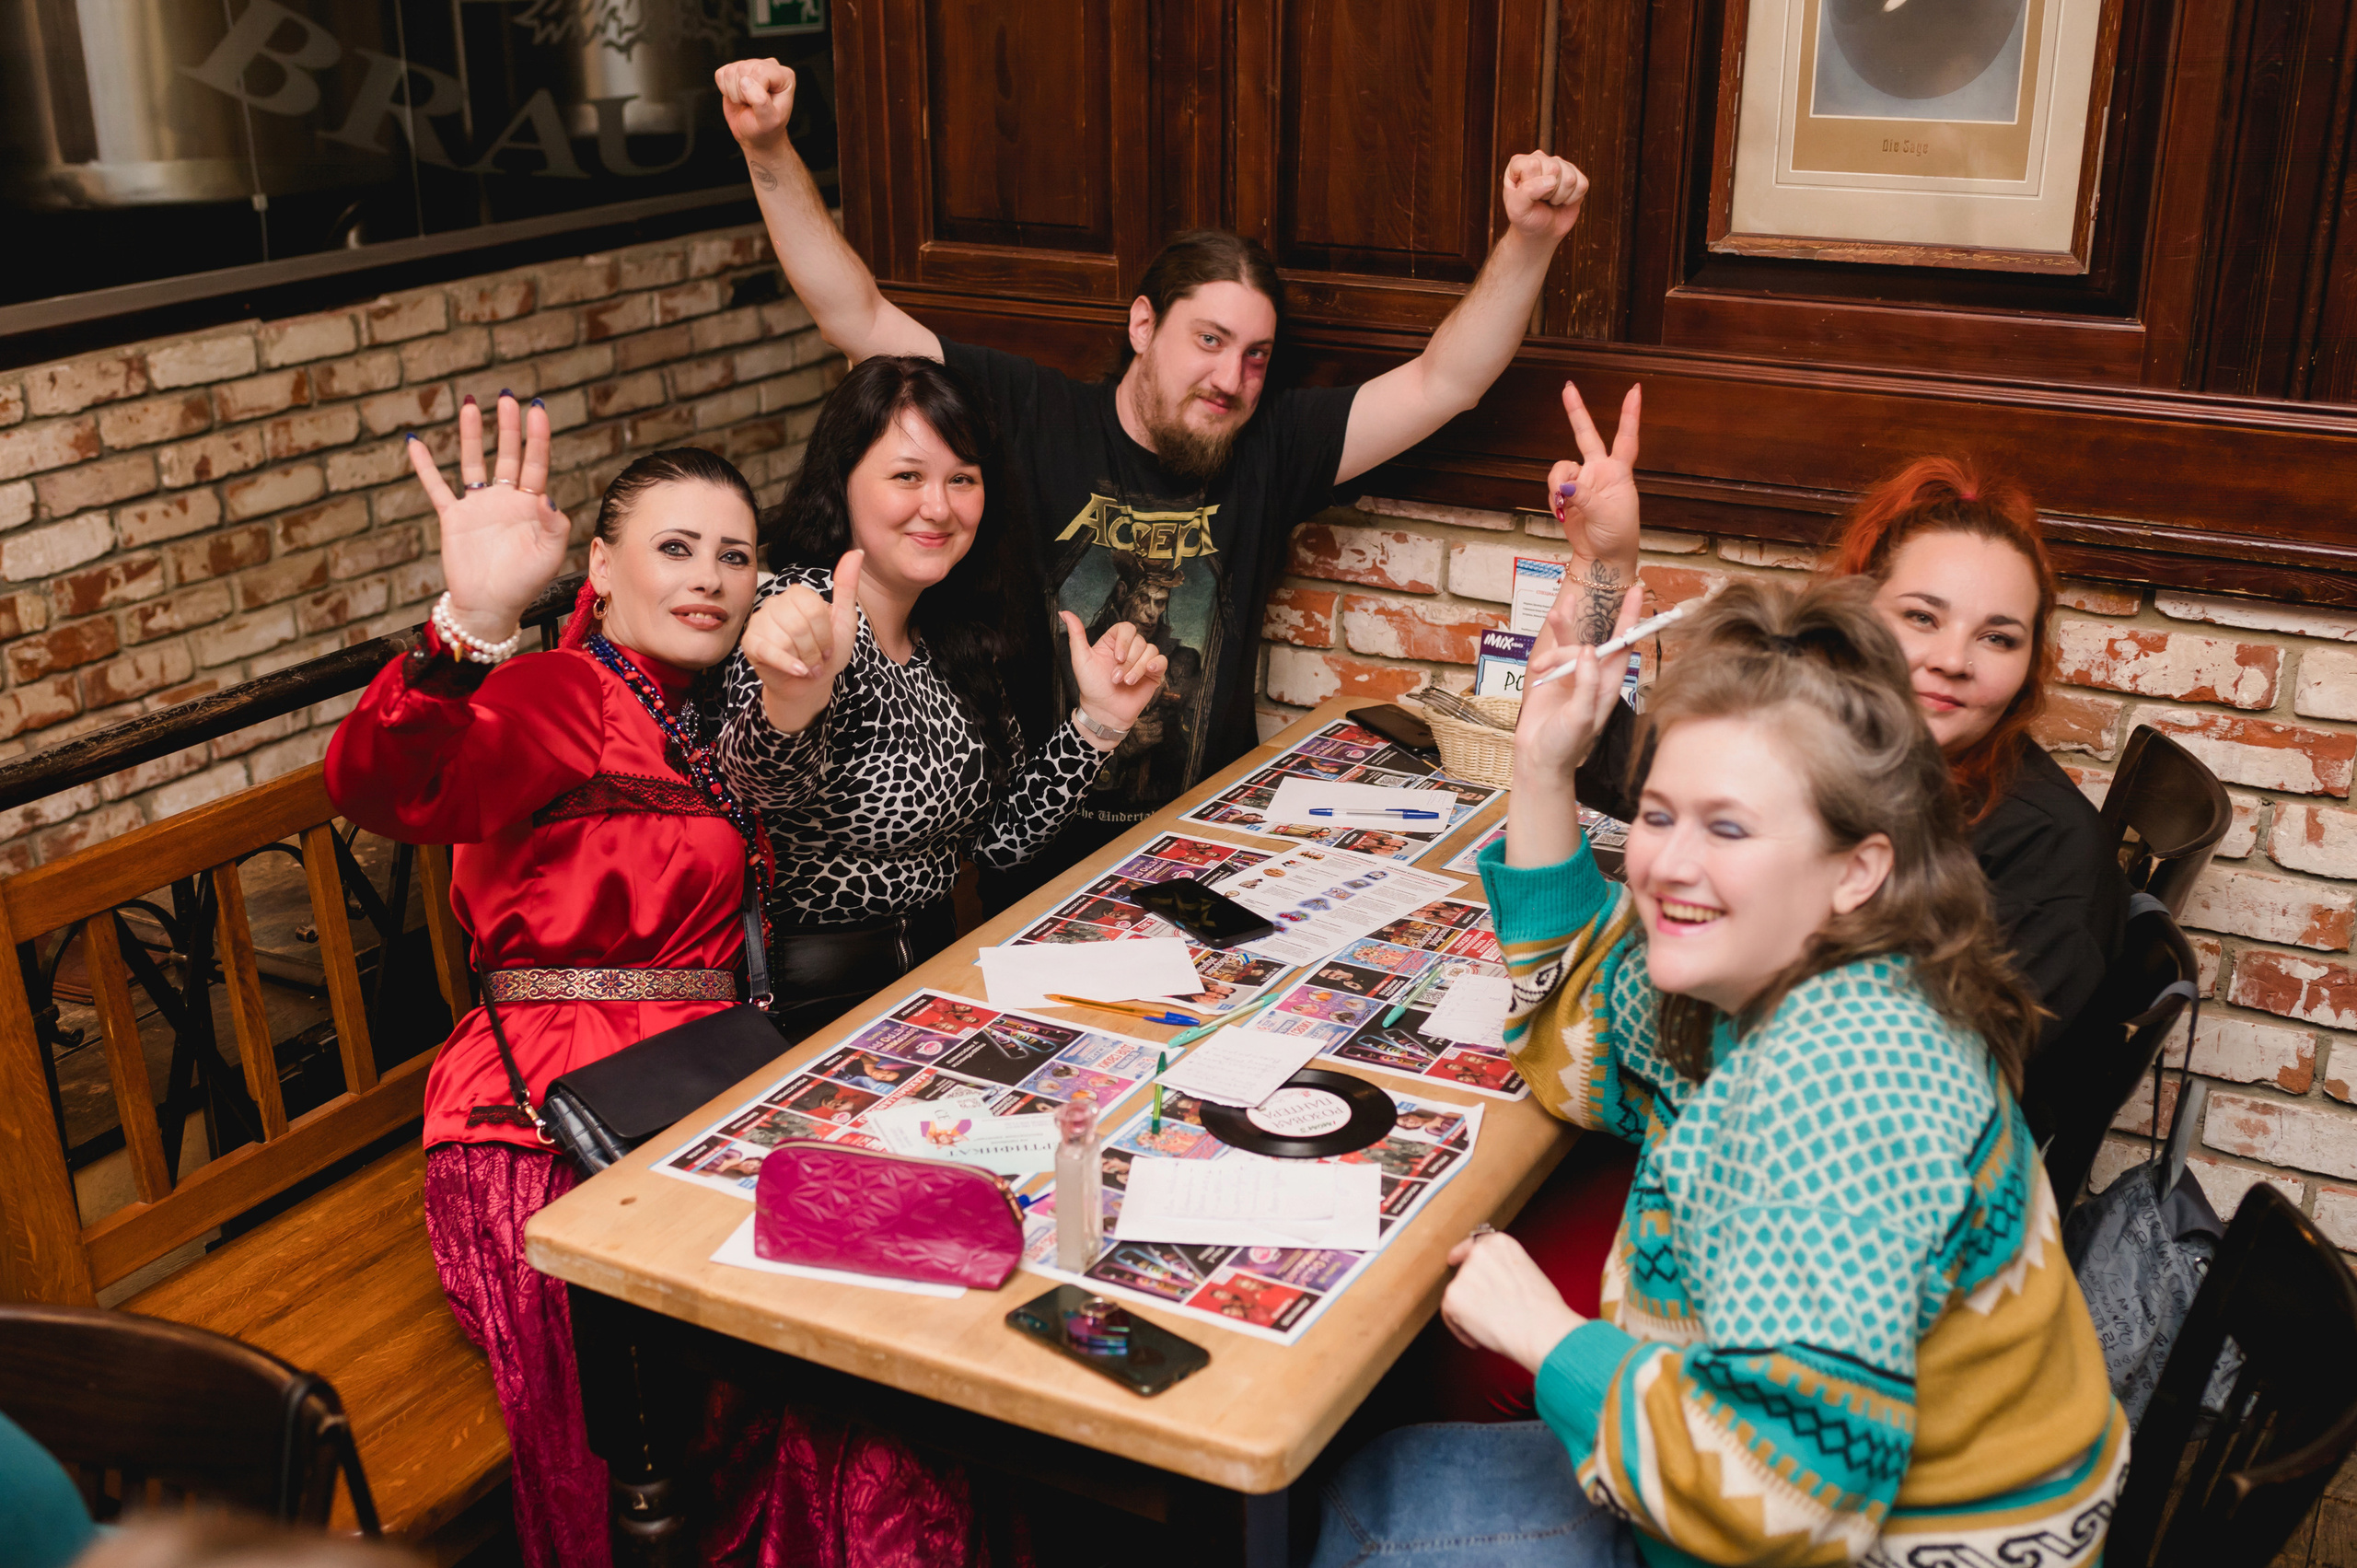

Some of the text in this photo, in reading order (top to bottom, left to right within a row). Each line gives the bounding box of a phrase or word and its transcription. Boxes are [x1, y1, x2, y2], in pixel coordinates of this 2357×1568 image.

[1882, 138, 1899, 154] Die
[1054, 493, 1221, 571] ACCEPT
[1098, 807, 1155, 822] Underta
[1260, 1098, 1333, 1120] ПАНТЕРА
[1271, 1107, 1345, 1130] РОЗОВАЯ
[946, 1143, 1052, 1157] РТИФИКАТ
